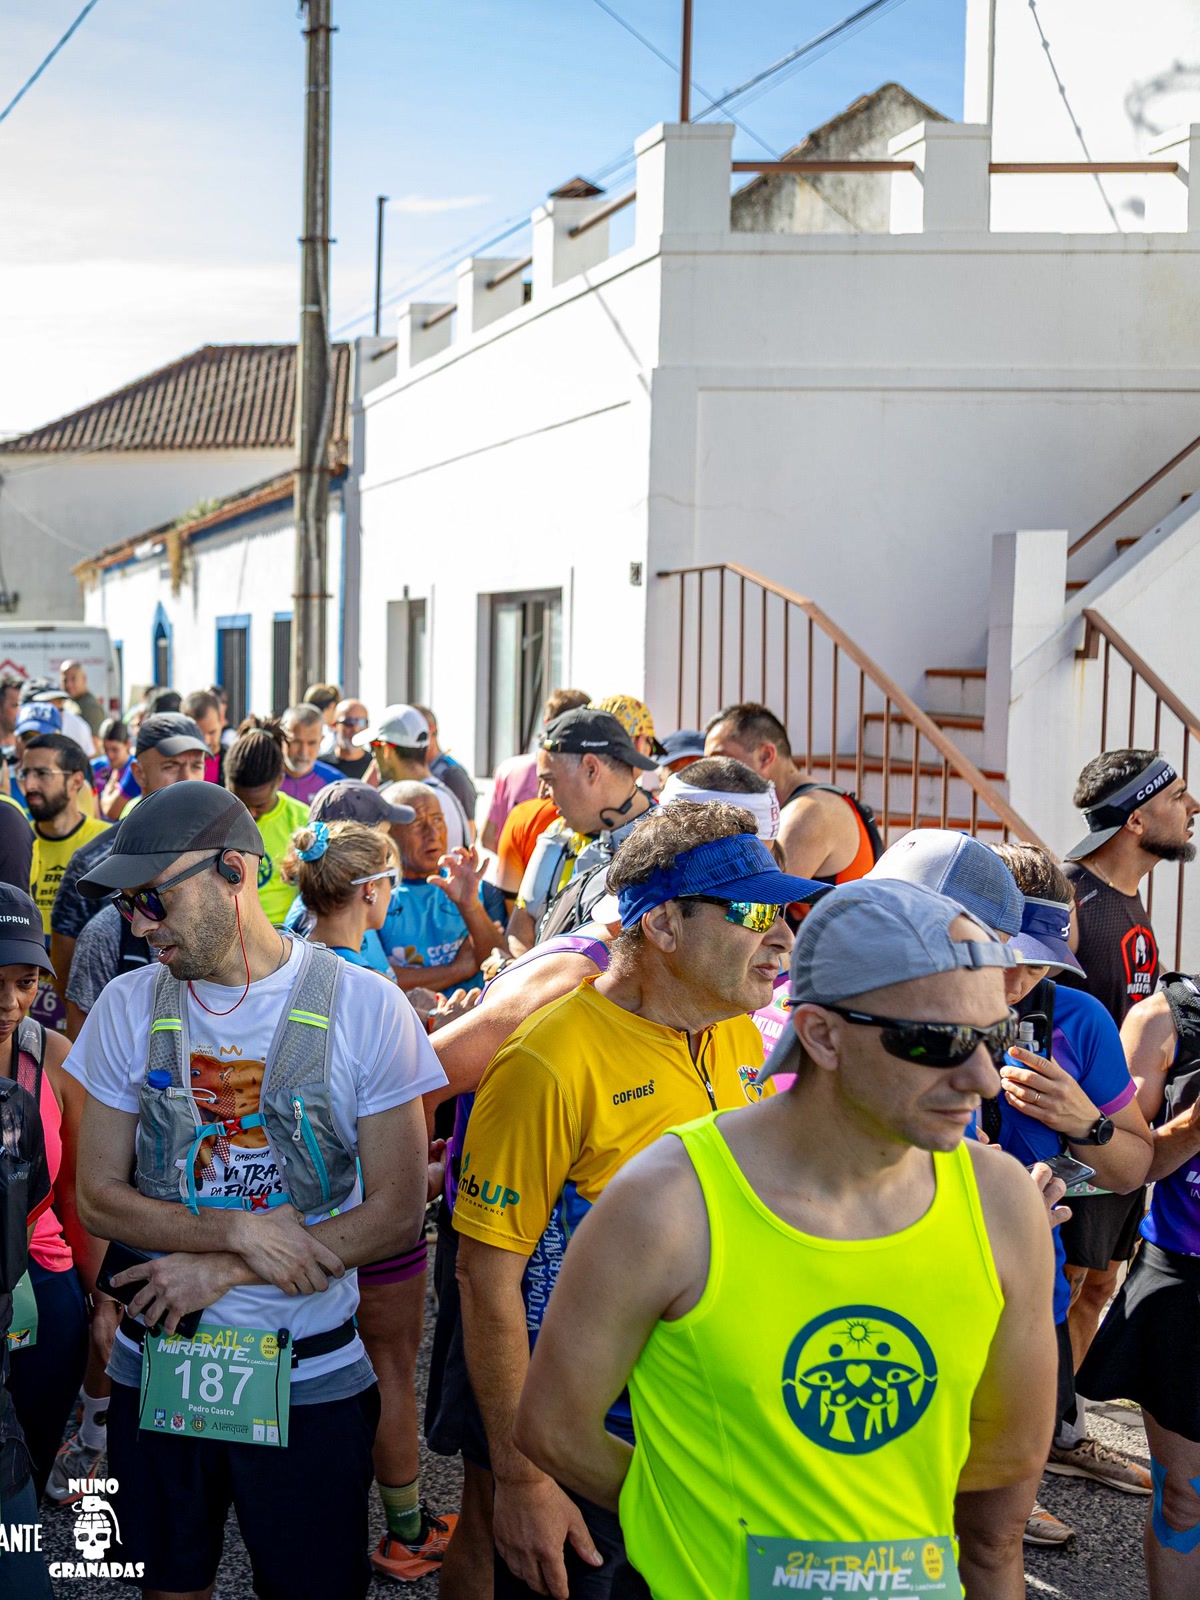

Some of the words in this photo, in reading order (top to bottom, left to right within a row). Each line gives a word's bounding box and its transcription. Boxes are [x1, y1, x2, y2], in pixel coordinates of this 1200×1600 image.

[613, 1082, 655, 1105] COFIDES
[211, 1186, 222, 1196] DA
[243, 1333, 254, 1343] do
[157, 1339, 251, 1361] MIRANTE
[174, 1359, 254, 1405] 187
[188, 1404, 209, 1413] Pedro
[211, 1407, 235, 1416] Castro
[211, 1421, 250, 1435] Alenquer
[902, 1547, 915, 1561] do
[927, 1548, 935, 1556] 07
[772, 1565, 912, 1592] MIRANTE
